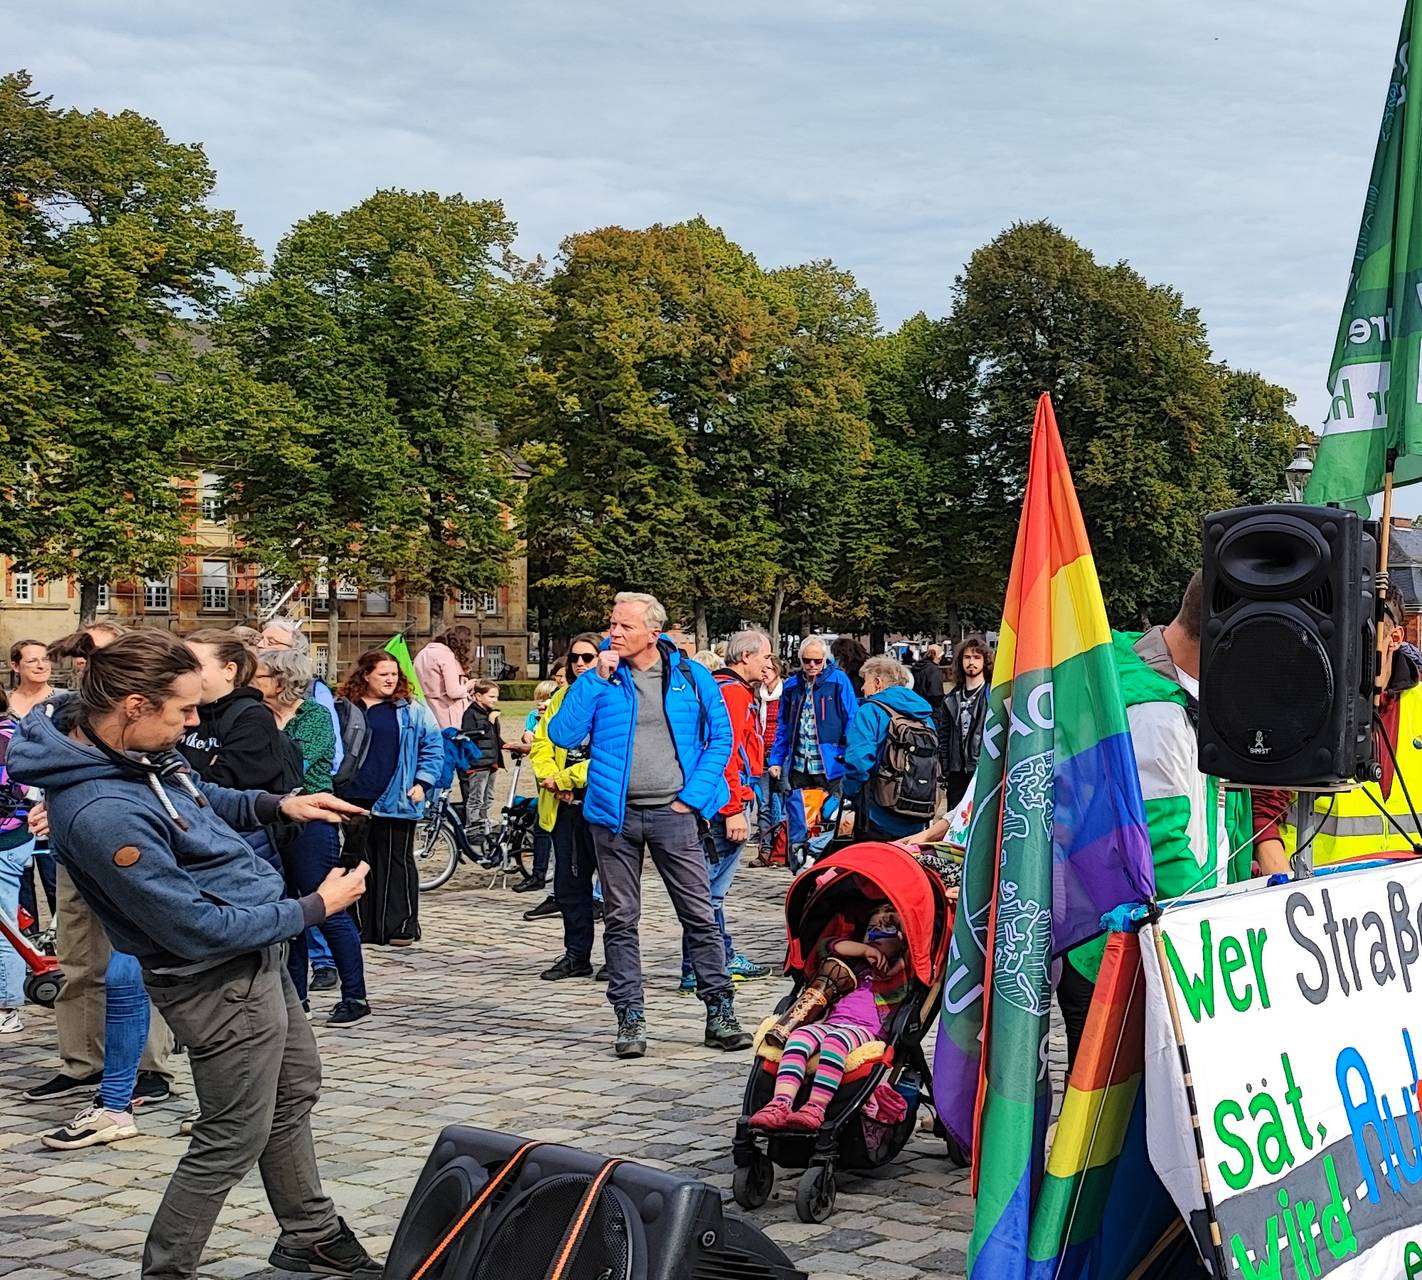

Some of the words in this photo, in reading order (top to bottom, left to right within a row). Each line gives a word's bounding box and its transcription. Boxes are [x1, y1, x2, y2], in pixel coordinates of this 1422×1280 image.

[1162, 918, 1271, 1023] Wer
[1213, 1052, 1328, 1190] sät,
[1231, 1154, 1358, 1280] wird
